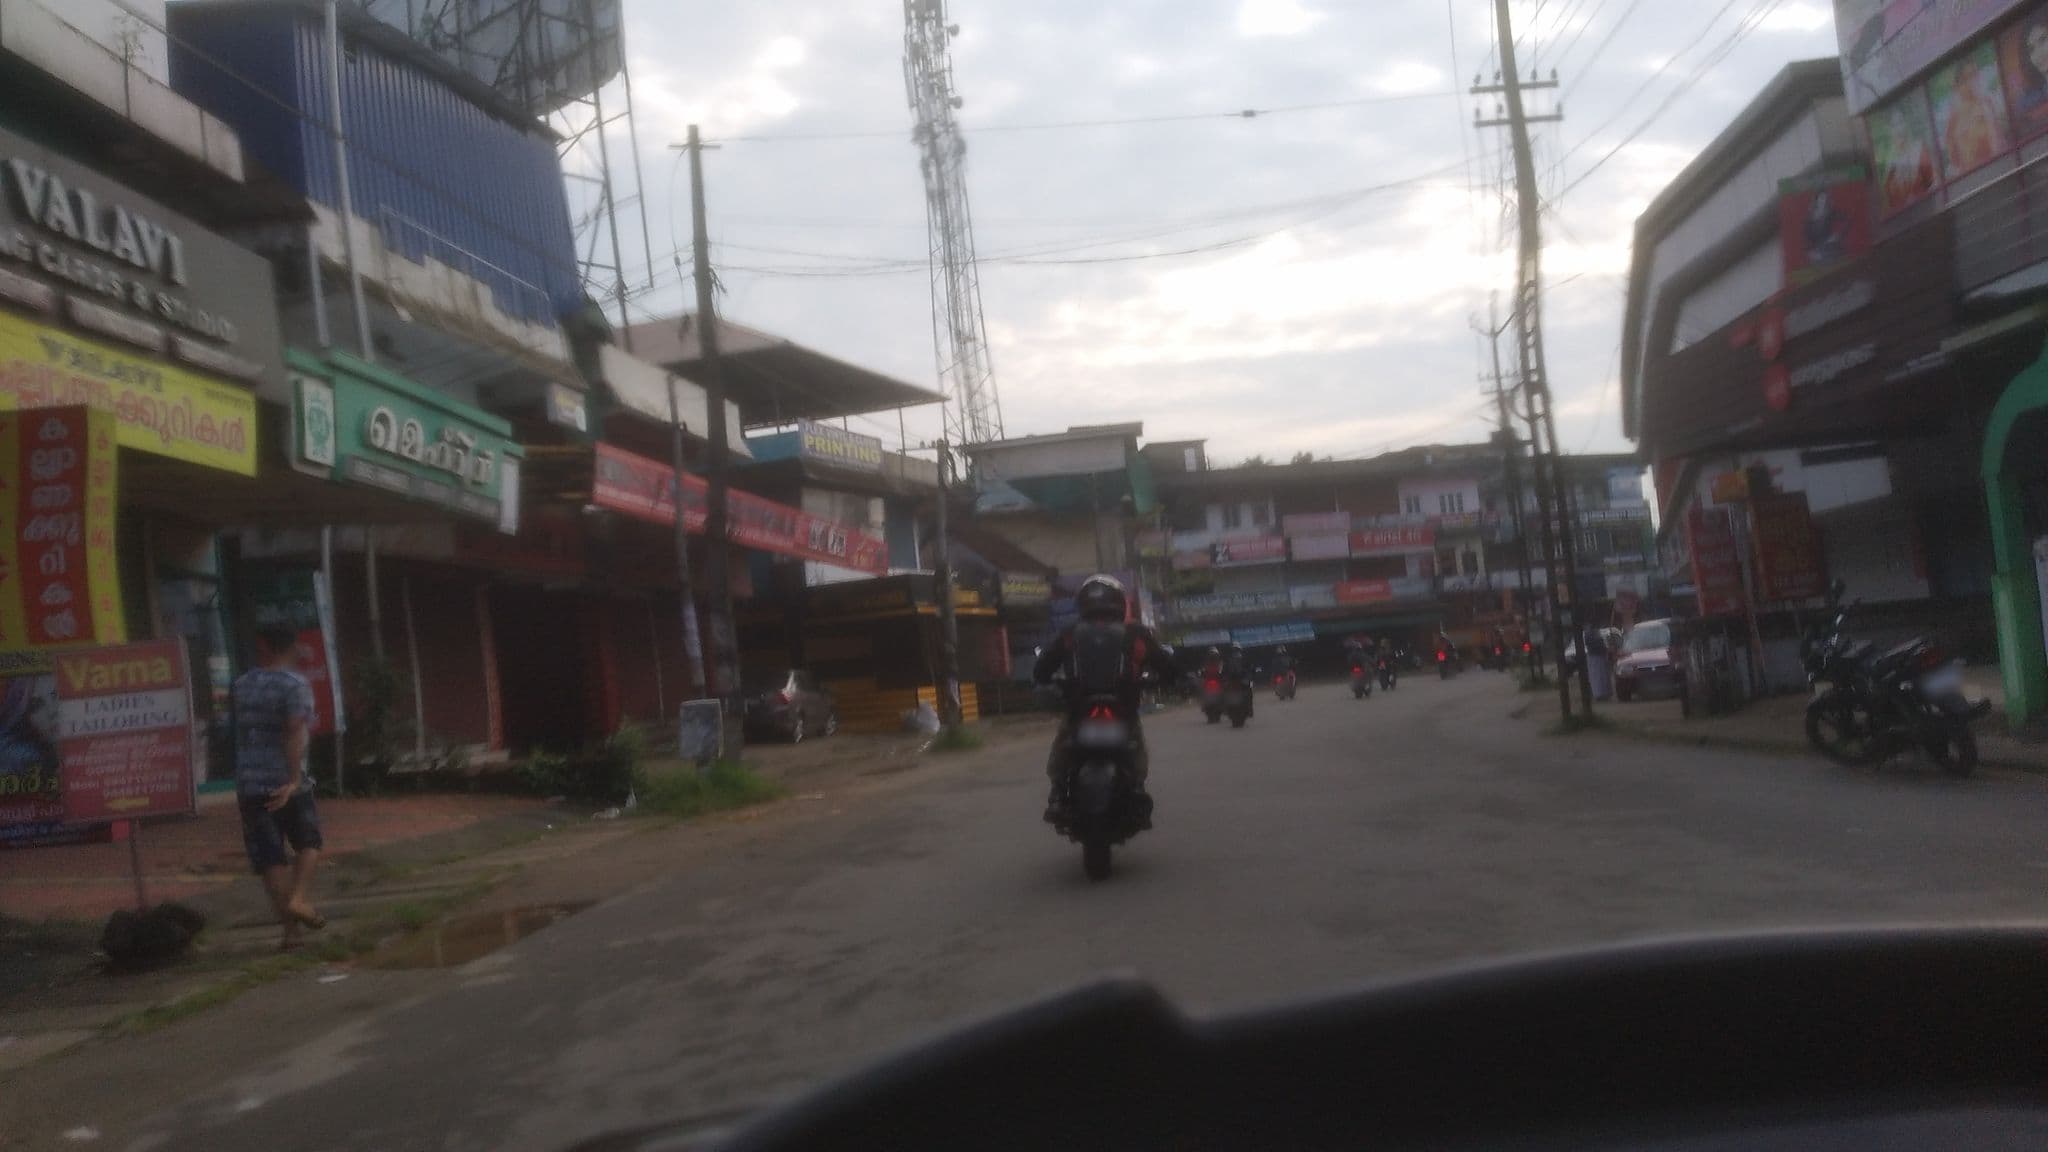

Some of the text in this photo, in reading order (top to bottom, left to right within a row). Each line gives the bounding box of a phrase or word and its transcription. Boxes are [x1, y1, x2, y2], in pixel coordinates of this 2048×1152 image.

[9, 157, 187, 287] VALAVI
[803, 431, 882, 464] PRINTING
[62, 655, 173, 691] Varna
[84, 694, 155, 717] LADIES
[70, 711, 177, 736] TAILORING
